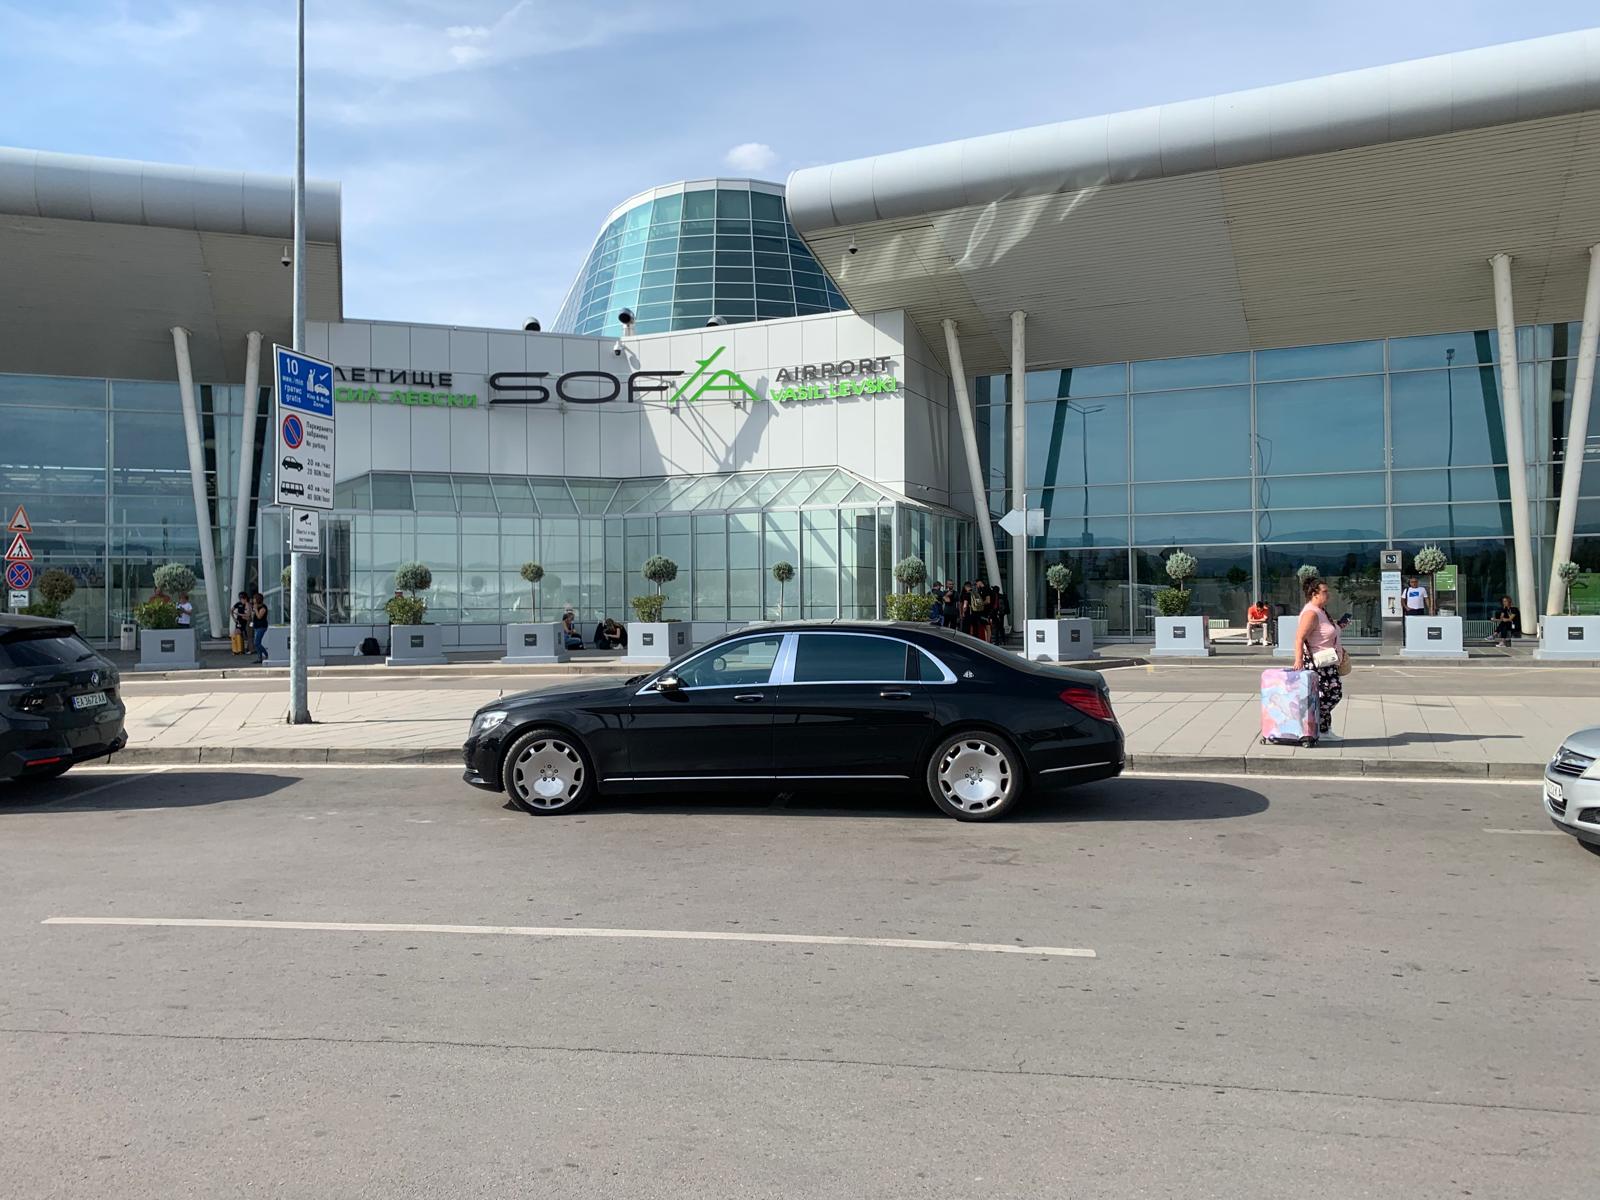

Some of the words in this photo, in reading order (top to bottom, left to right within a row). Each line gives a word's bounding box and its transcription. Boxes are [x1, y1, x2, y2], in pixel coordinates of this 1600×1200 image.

[286, 357, 299, 375] 10
[775, 356, 891, 383] AIRPORT
[489, 345, 761, 405] SOFIA
[284, 384, 302, 395] гратис
[770, 384, 825, 402] VASIL
[829, 377, 898, 399] LEVSKI
[285, 393, 302, 404] gratis
[335, 387, 382, 403] СИЛ
[389, 389, 479, 409] ЛЕВСКИ
[306, 439, 311, 447] No
[312, 442, 326, 453] parking
[307, 457, 314, 466] 20
[307, 483, 314, 491] 40
